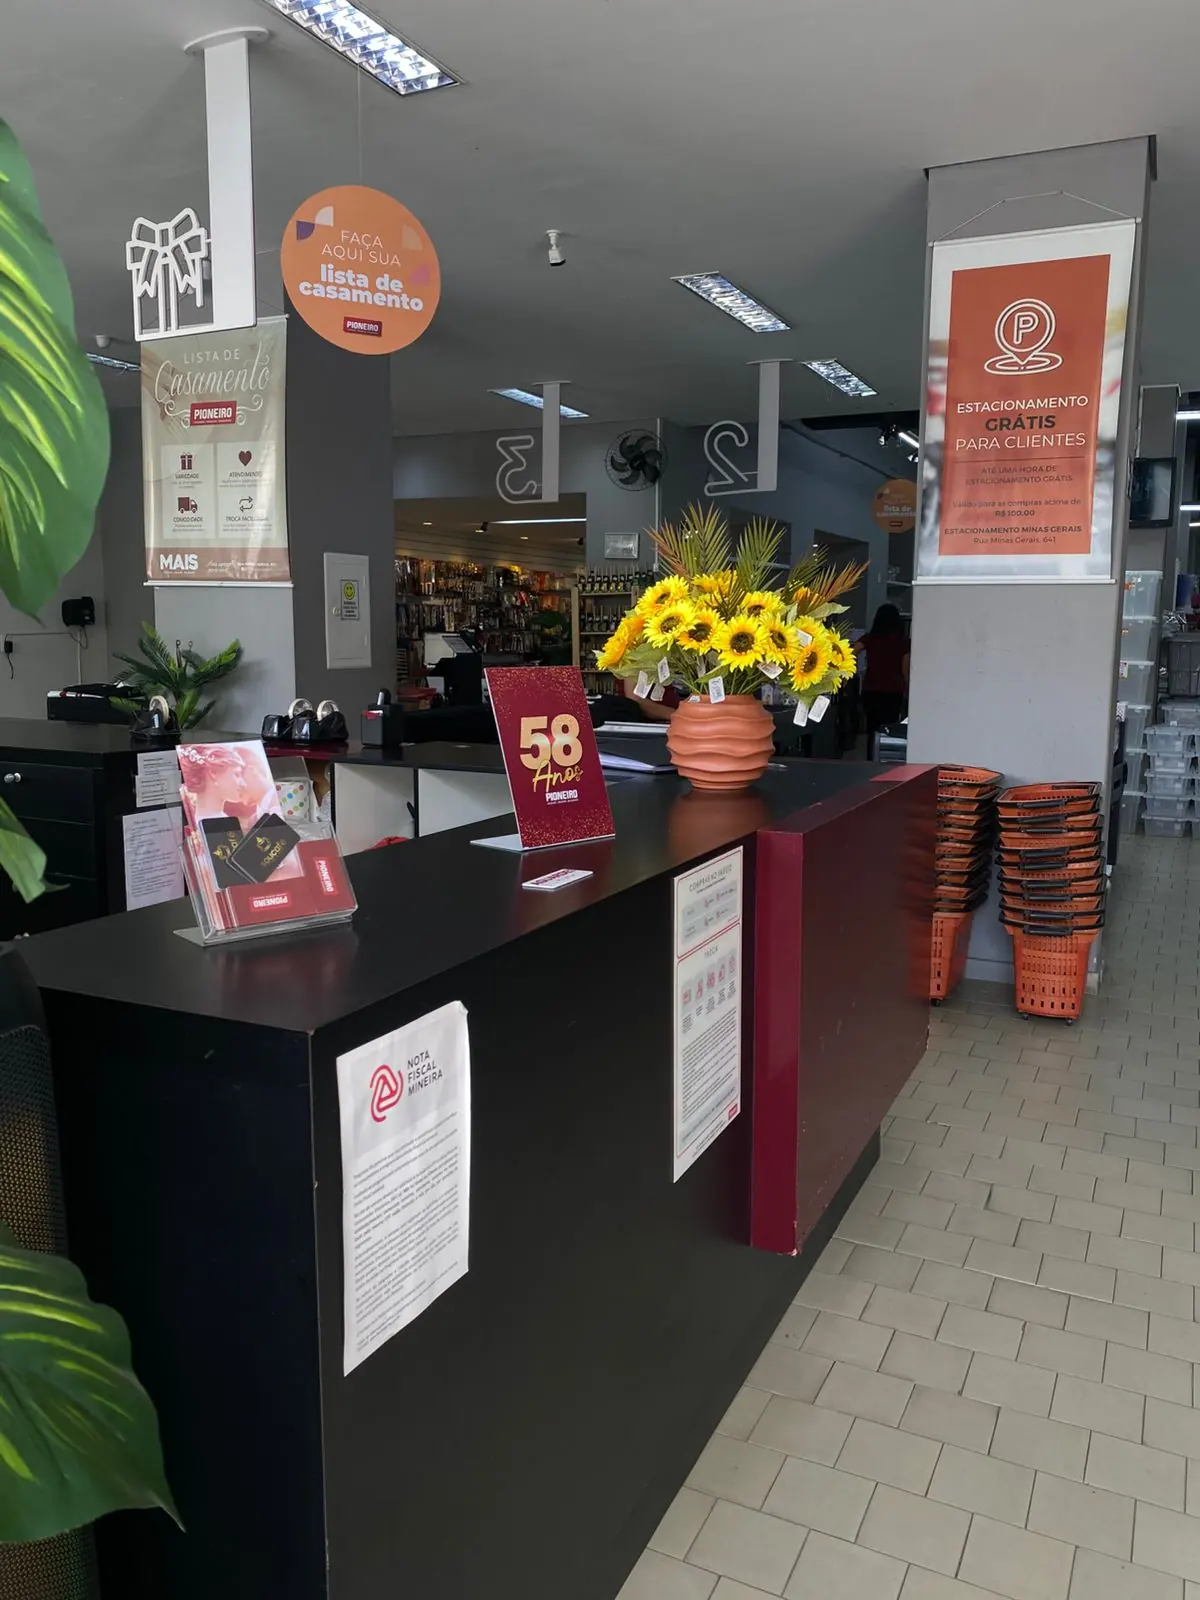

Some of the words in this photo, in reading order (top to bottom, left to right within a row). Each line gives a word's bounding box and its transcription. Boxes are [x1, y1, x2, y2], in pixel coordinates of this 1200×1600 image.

[341, 229, 384, 250] FAÇA
[321, 243, 364, 262] AQUI
[369, 250, 401, 267] SUA
[320, 263, 369, 288] lista
[375, 273, 404, 292] de
[298, 281, 424, 311] casamento
[346, 320, 379, 332] PIONEIRO
[184, 351, 219, 364] LISTA
[224, 349, 240, 361] DE
[155, 341, 270, 403] Casamento
[957, 395, 1089, 413] ESTACIONAMENTO
[194, 407, 233, 420] PIONEIRO
[985, 413, 1056, 432] GRÁTIS
[956, 437, 1000, 451] PARA
[1004, 433, 1086, 449] CLIENTES
[1020, 466, 1044, 474] HORA
[966, 476, 1042, 485] ESTACIONAMENTO
[1007, 500, 1043, 508] compras
[944, 527, 1019, 535] ESTACIONAMENTO
[1050, 525, 1082, 533] GERAIS
[160, 554, 199, 570] MAIS
[520, 713, 583, 770] 58
[532, 759, 583, 793] Anos
[546, 789, 578, 802] PIONEIRO
[408, 1050, 430, 1070] NOTA
[408, 1060, 437, 1084] FISCAL
[408, 1069, 443, 1097] MINEIRA
